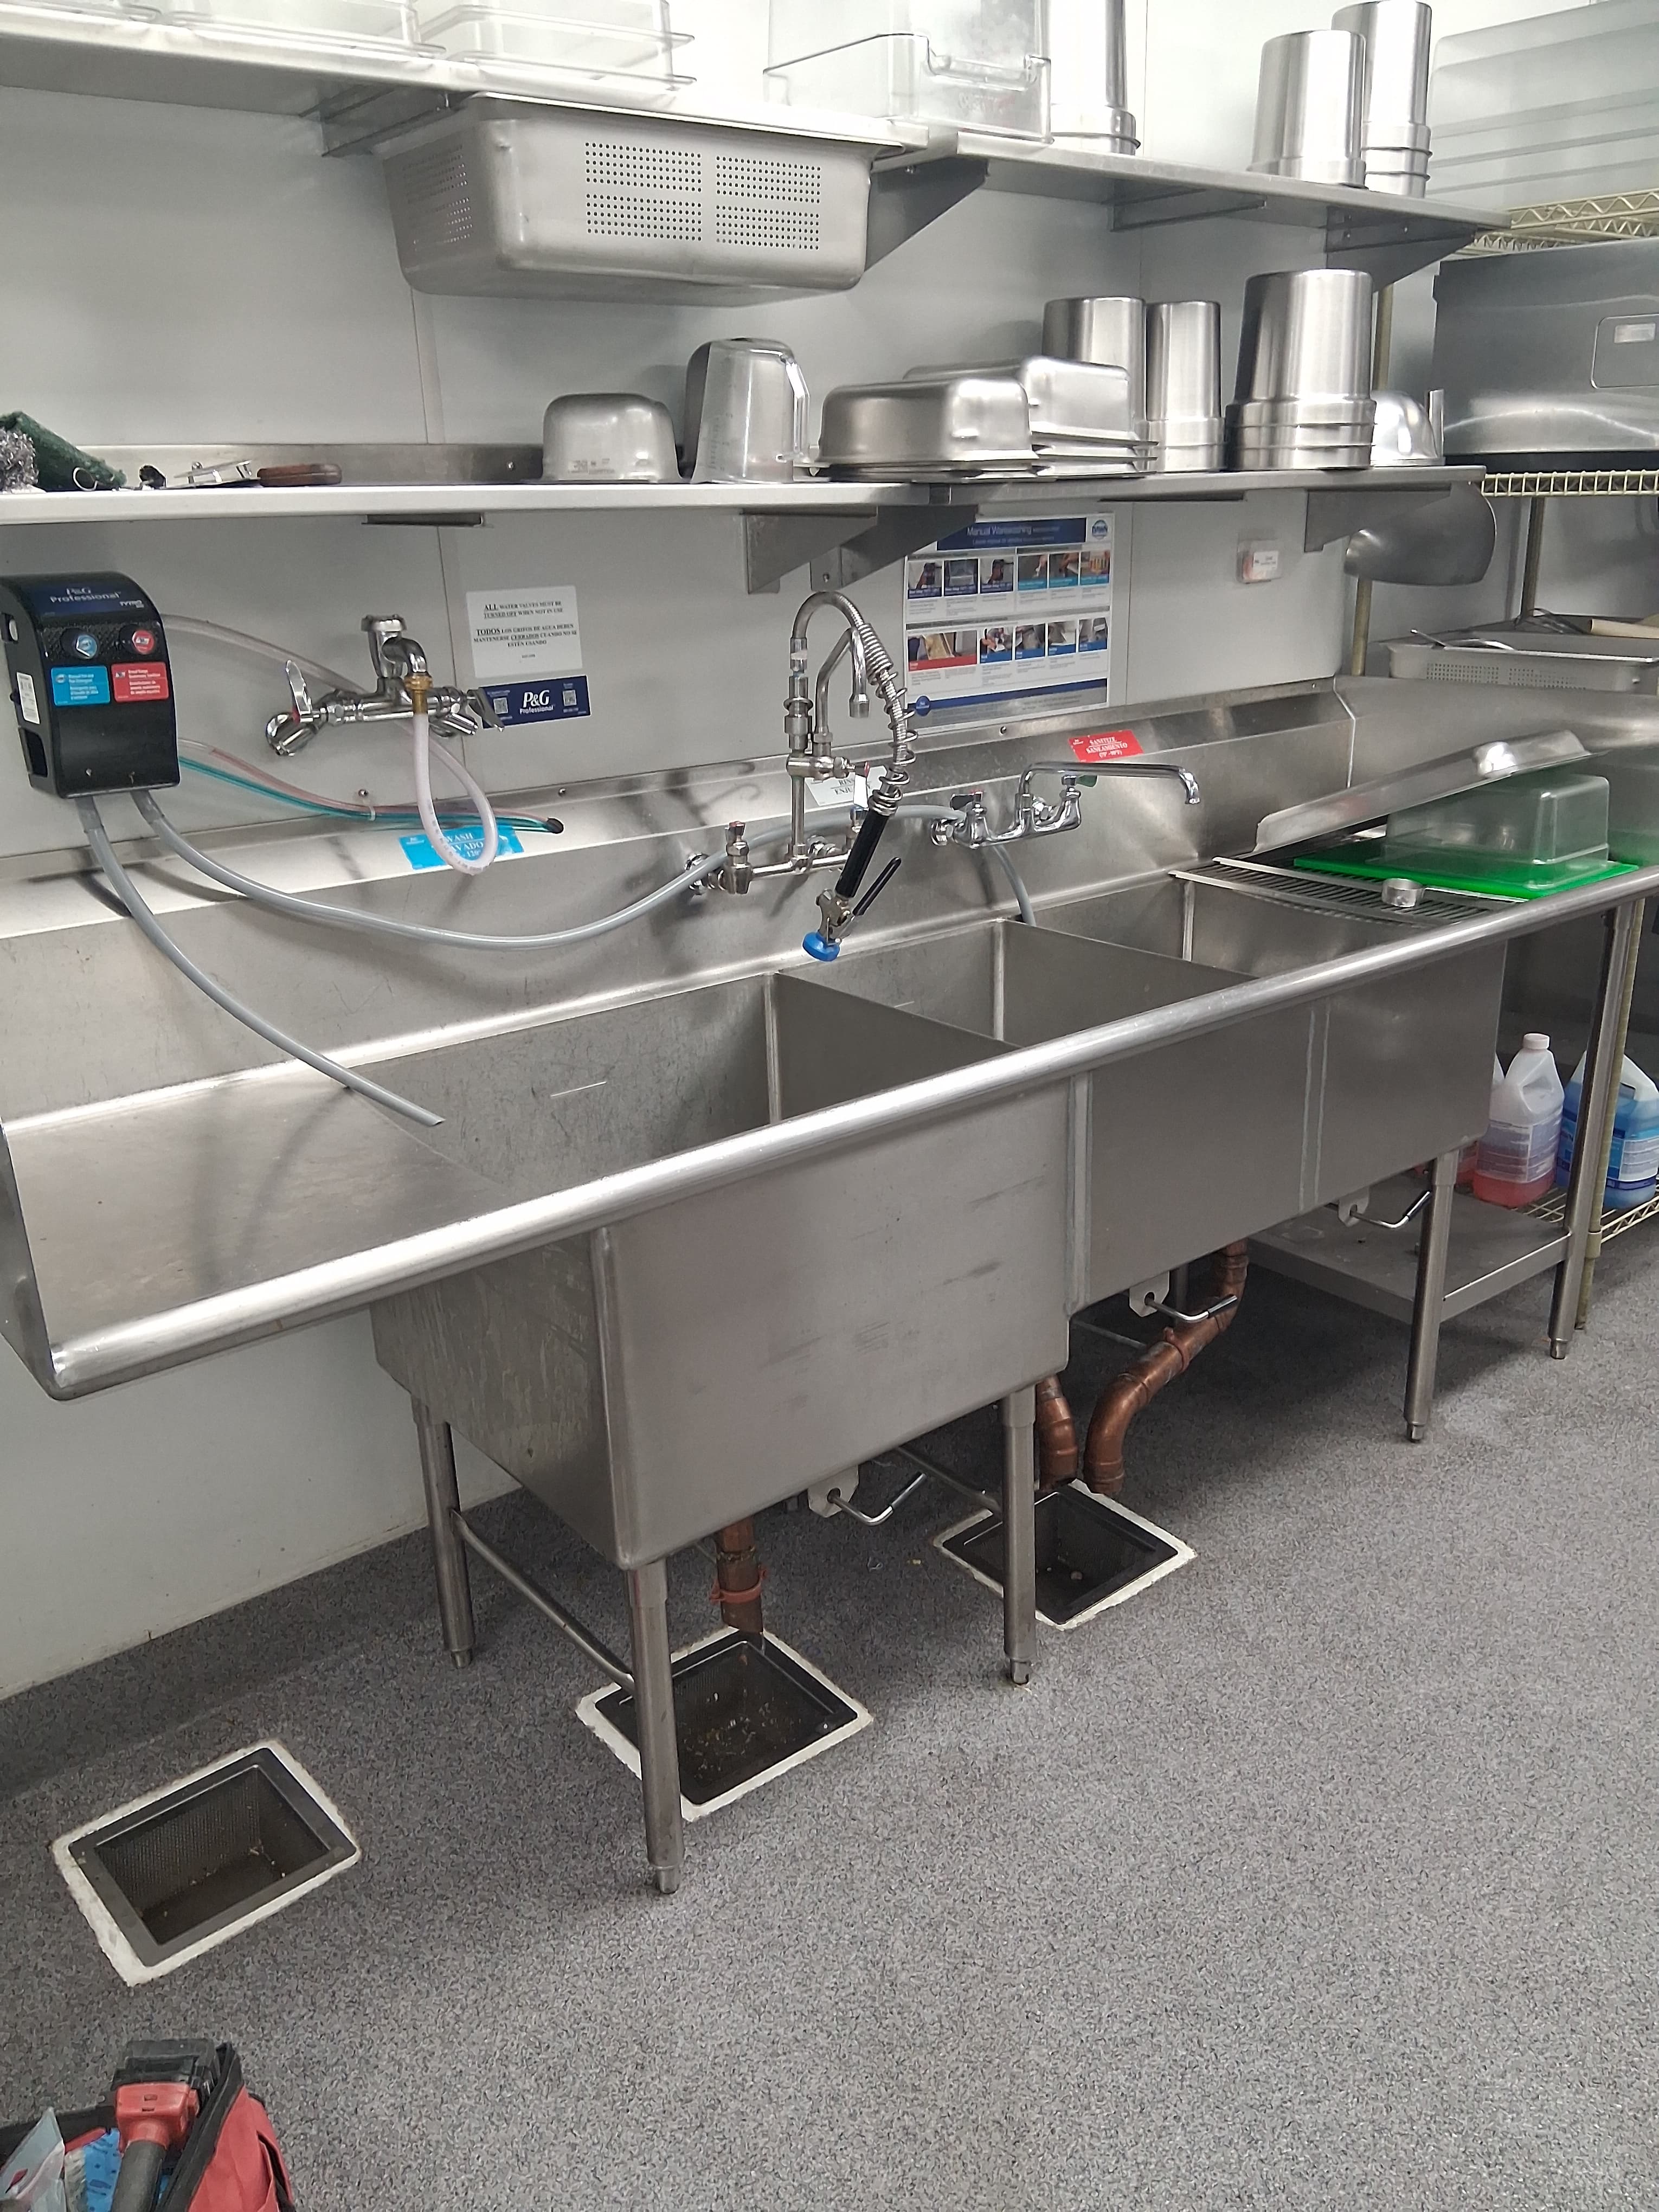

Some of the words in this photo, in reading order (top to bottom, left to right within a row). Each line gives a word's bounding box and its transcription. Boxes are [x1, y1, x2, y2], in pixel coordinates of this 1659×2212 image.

[50, 592, 120, 603] Professional
[476, 628, 500, 636] TODOS
[523, 690, 550, 708] P&G
[519, 705, 554, 715] Professional
